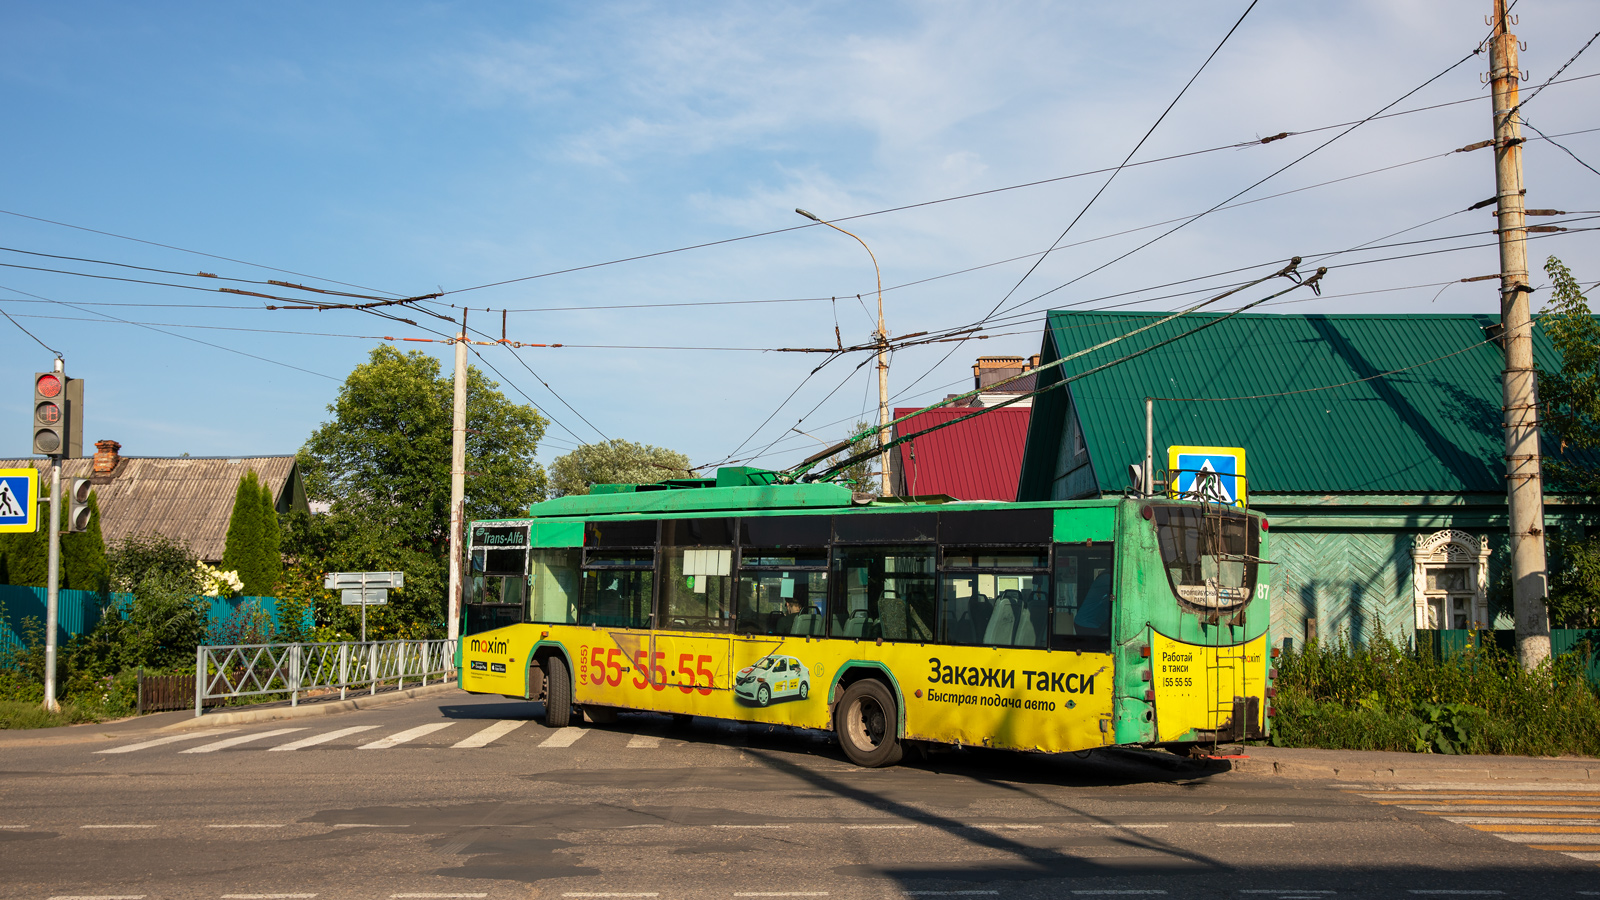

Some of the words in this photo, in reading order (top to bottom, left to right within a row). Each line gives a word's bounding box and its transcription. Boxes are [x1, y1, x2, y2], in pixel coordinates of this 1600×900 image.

[483, 531, 524, 544] Trans-Alfa
[528, 574, 537, 586] 87
[1257, 583, 1269, 600] 87
[1162, 651, 1192, 662] Работай
[580, 644, 589, 686] (4855)
[1162, 665, 1167, 673] в
[1168, 665, 1189, 673] такси
[927, 657, 1015, 689] Закажи
[1022, 671, 1095, 695] такси
[927, 688, 978, 706] Быстрая
[980, 693, 1022, 709] подача
[1024, 699, 1056, 712] авто
